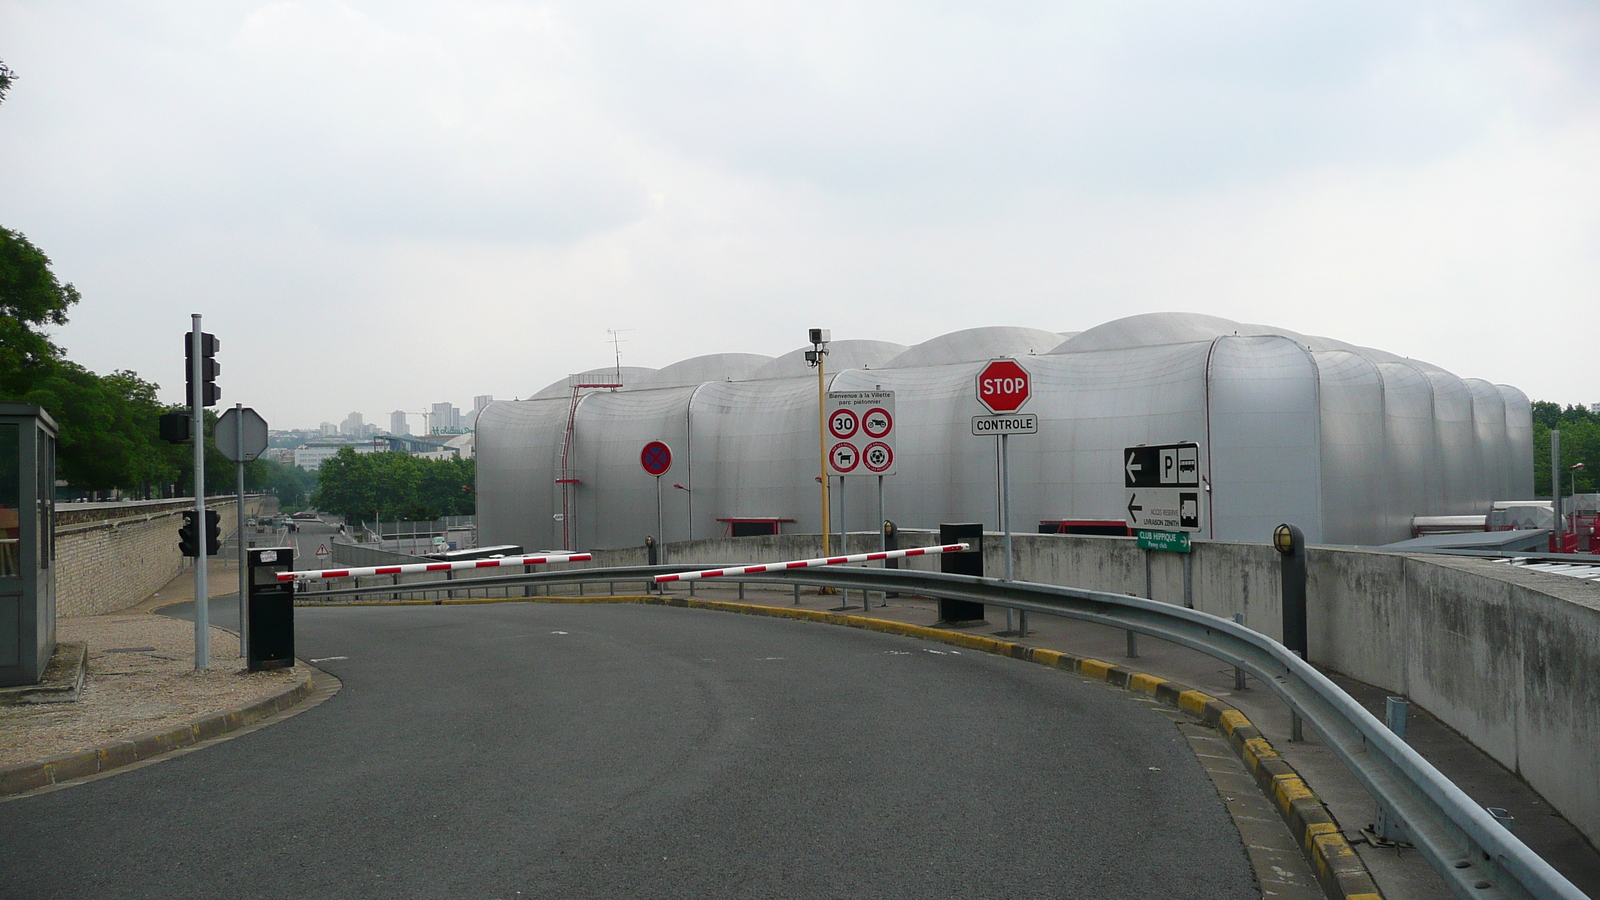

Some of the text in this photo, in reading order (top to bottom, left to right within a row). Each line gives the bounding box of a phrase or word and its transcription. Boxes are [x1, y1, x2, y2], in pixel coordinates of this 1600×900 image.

[983, 378, 1025, 395] STOP
[835, 418, 853, 430] 30
[977, 419, 1033, 430] CONTROLE
[1165, 456, 1173, 478] P
[1140, 531, 1176, 542] CLUB HIPPIQUE
